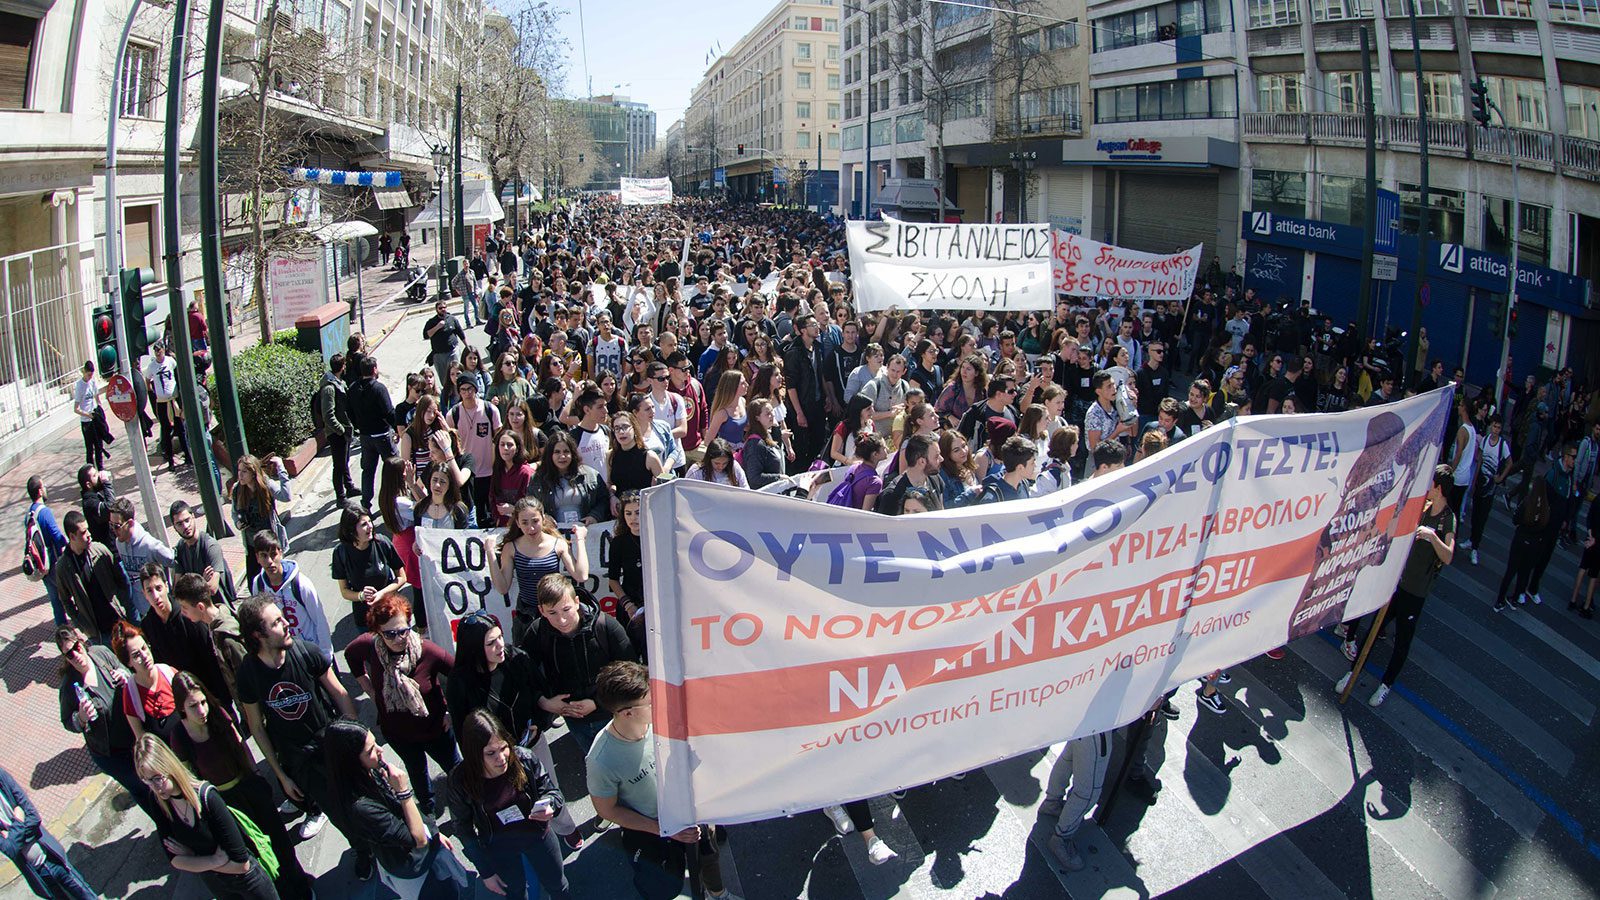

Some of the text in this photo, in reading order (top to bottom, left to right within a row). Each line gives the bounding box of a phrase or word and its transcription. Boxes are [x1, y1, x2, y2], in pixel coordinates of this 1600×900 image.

[1096, 137, 1162, 153] Aegean College
[865, 224, 1050, 262] ΣΙΒΙΤΑΝΙΔΕΙΟΣ
[1276, 220, 1336, 241] attica bank
[1470, 256, 1507, 277] attica
[908, 272, 1008, 307] ΣΧΟΛΗ
[597, 354, 619, 375] 86
[689, 530, 901, 584] ΟΥΤΕ
[1323, 572, 1349, 595] ΔΕΝ
[691, 613, 763, 650] ΤΟ
[990, 664, 1095, 713] Επιτροπή
[1187, 610, 1252, 640] Αθήνας
[829, 664, 907, 713] ΝΑ
